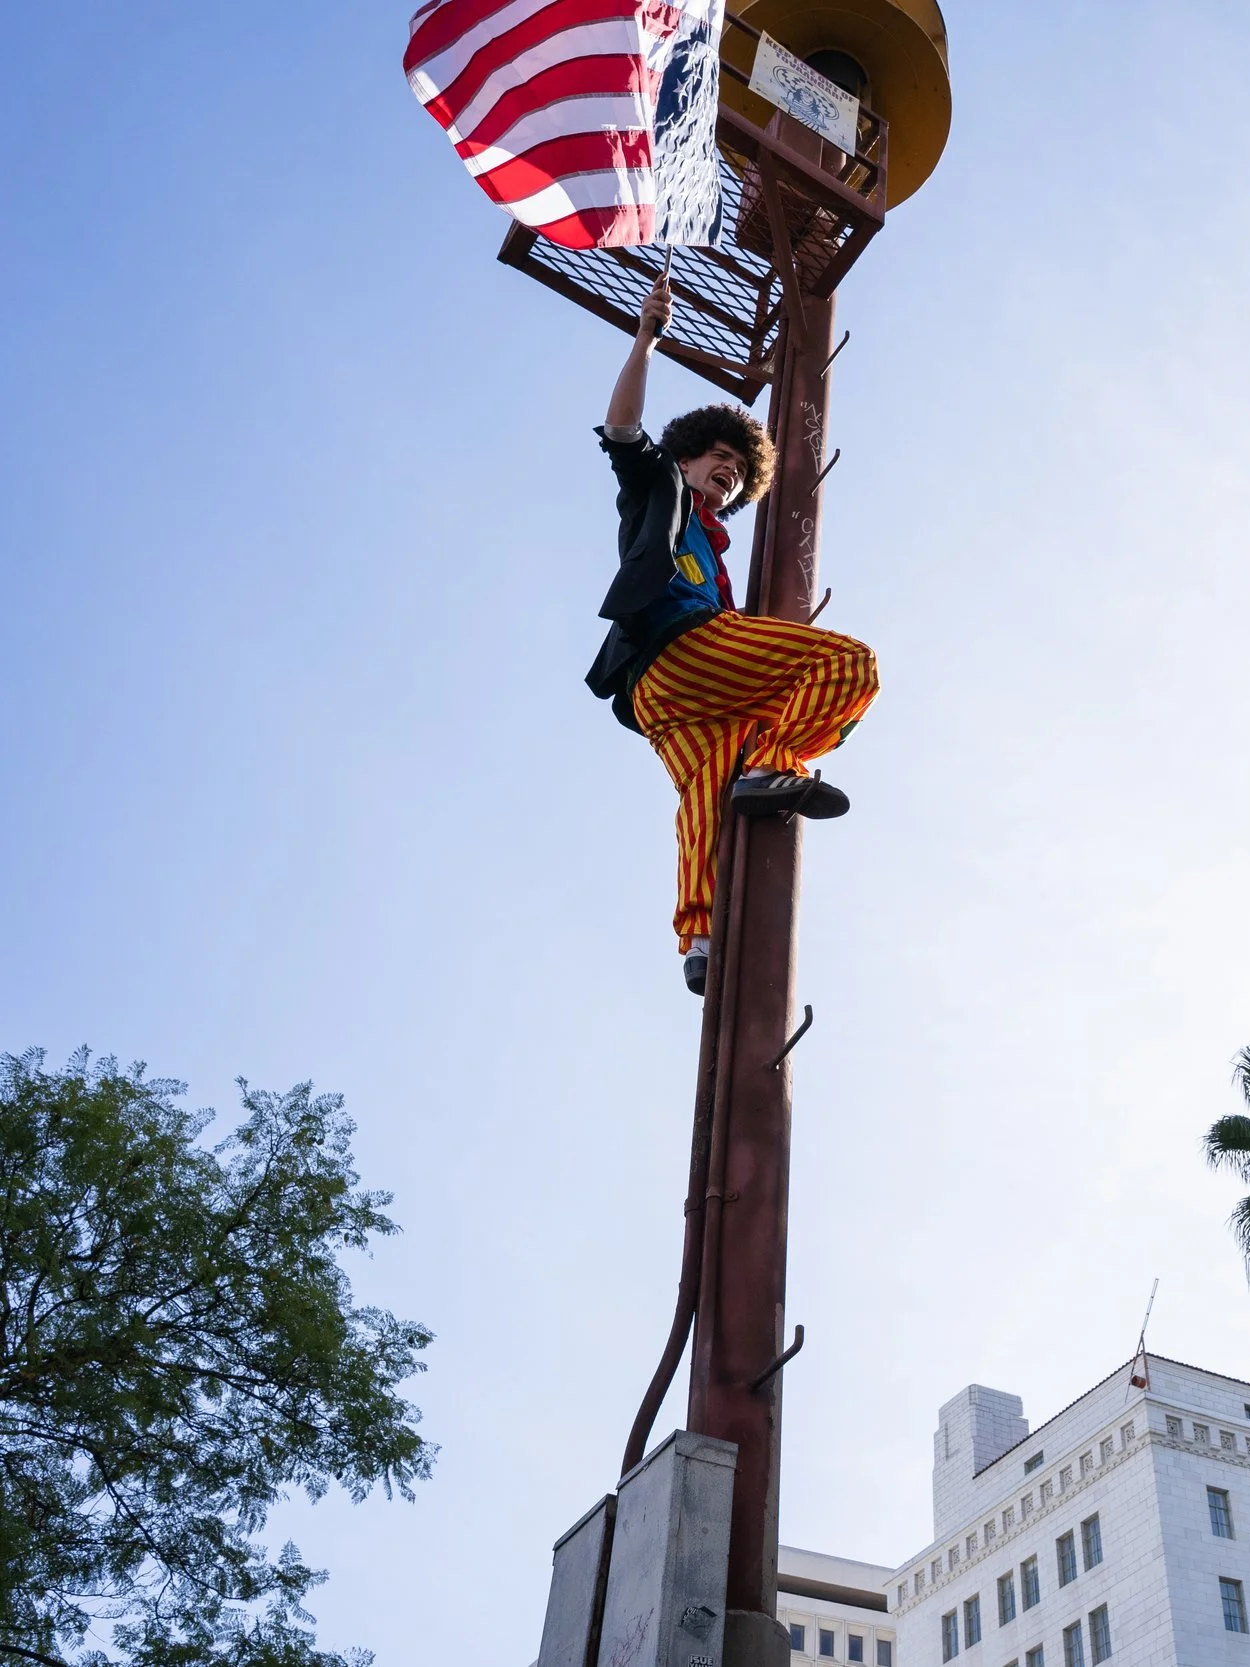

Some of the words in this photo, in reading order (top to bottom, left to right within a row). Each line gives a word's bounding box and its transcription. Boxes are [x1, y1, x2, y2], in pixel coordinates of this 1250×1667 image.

[765, 37, 791, 58] KEEP
[818, 75, 838, 92] OUT
[841, 91, 854, 102] OF
